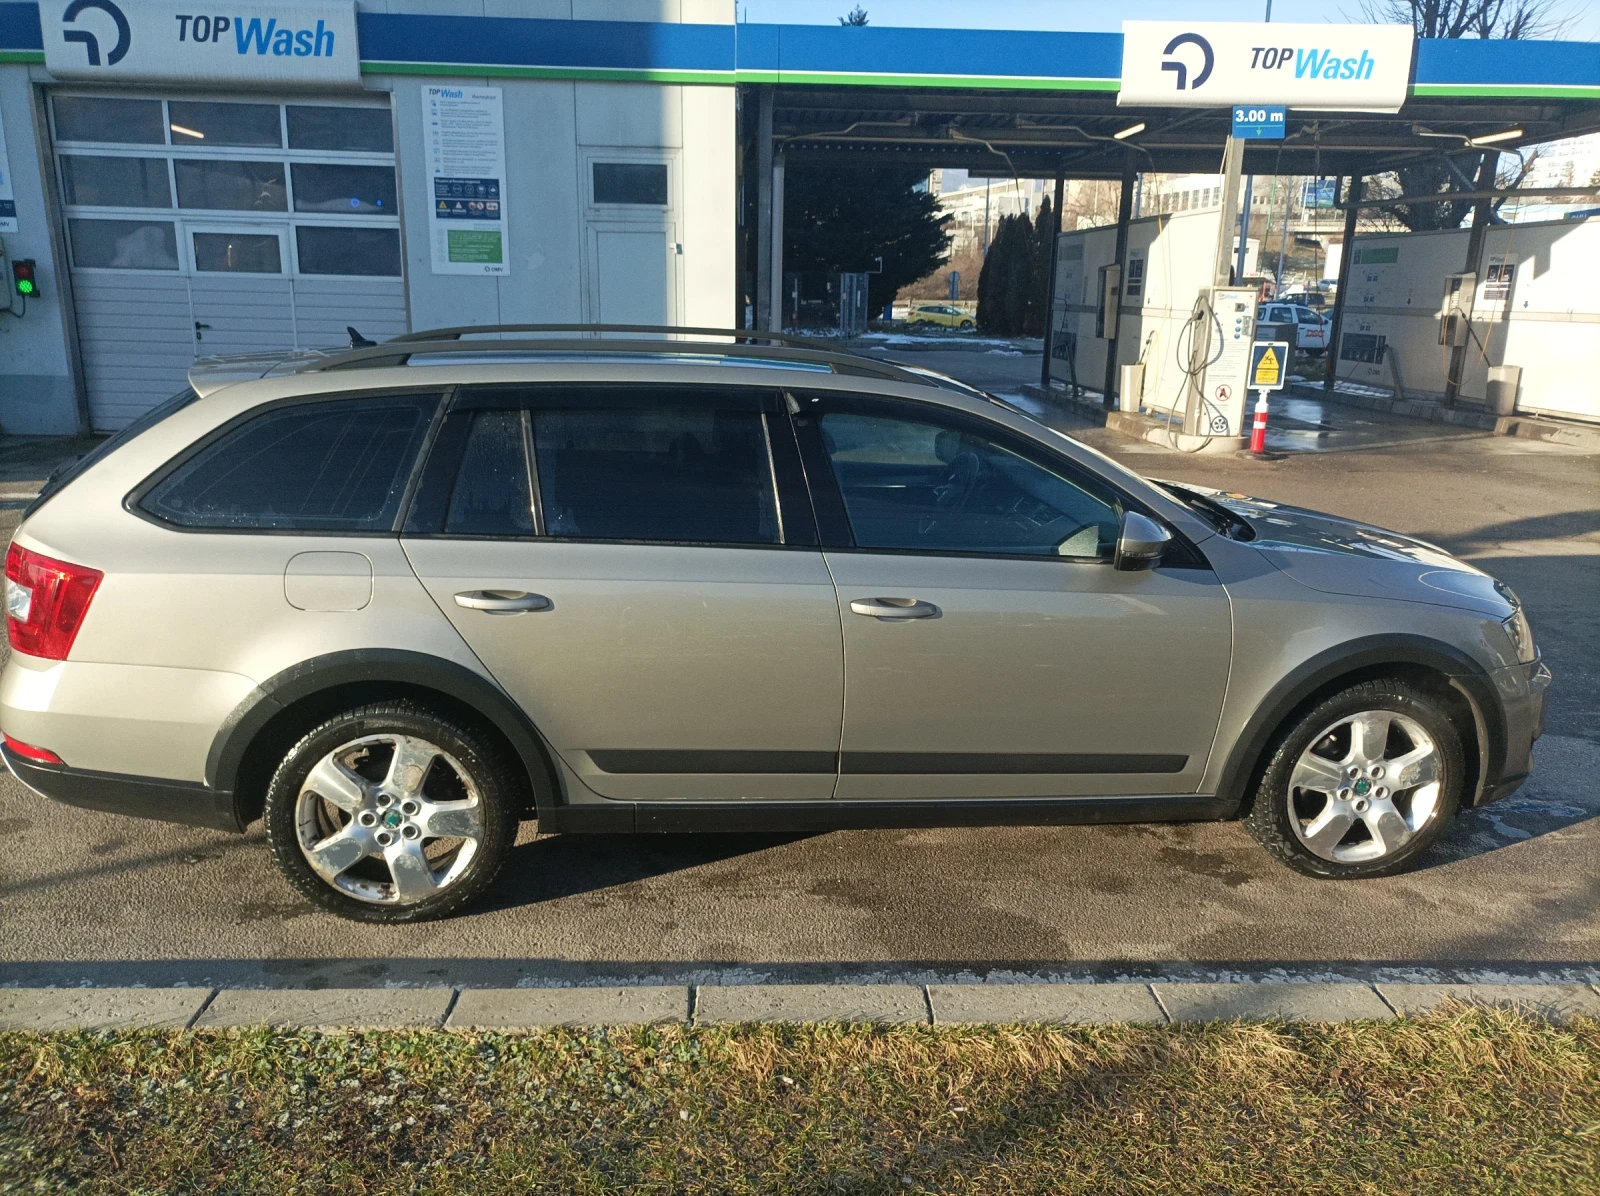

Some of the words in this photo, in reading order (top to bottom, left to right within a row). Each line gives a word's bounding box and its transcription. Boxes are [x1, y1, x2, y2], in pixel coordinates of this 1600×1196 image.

[176, 14, 231, 43] TOP
[234, 17, 335, 57] Wash
[1251, 47, 1294, 69] TOP
[1295, 48, 1375, 80] Wash
[1235, 110, 1266, 122] 3.00
[1270, 112, 1283, 122] m
